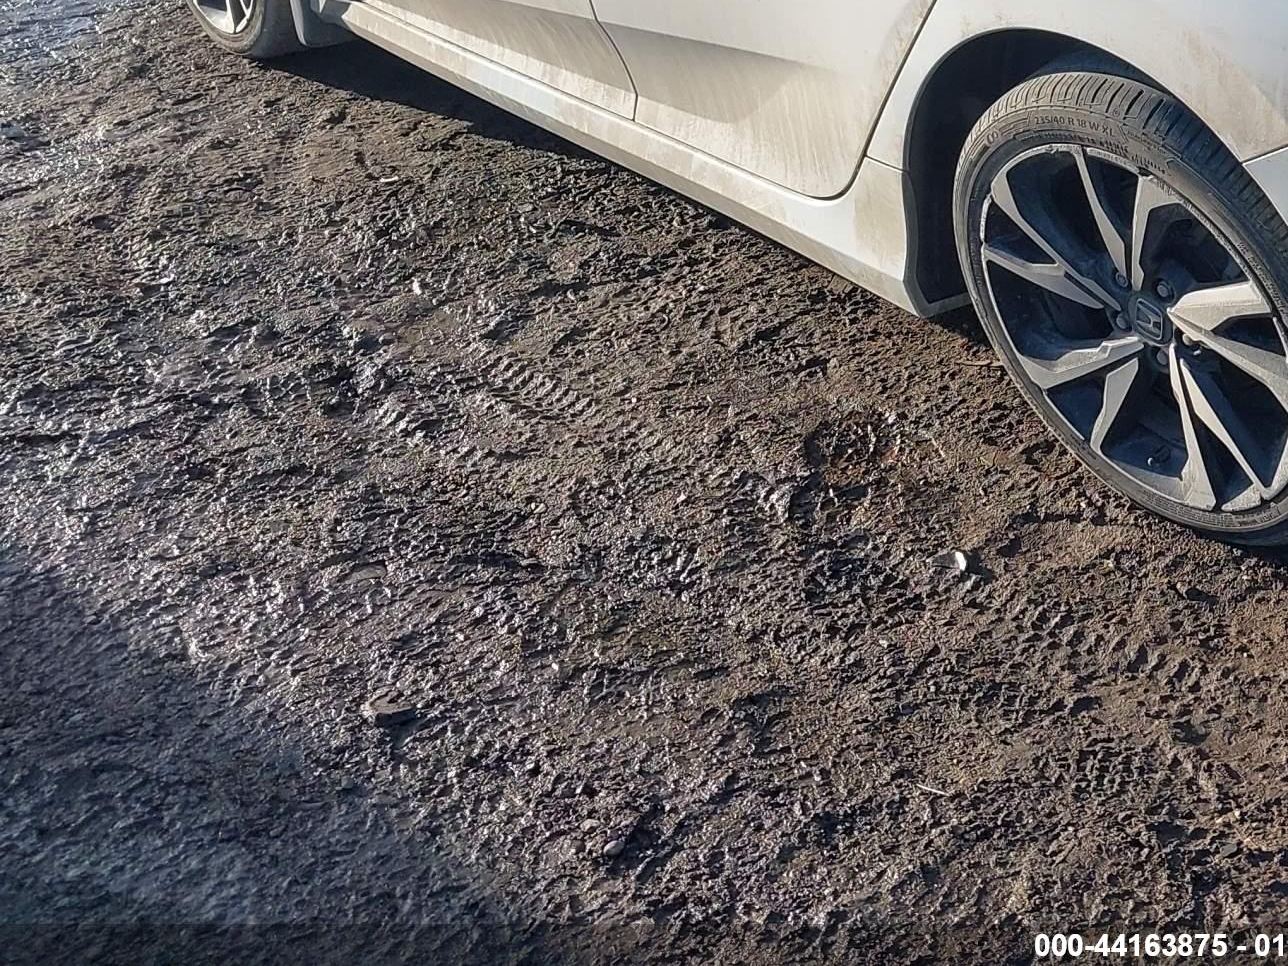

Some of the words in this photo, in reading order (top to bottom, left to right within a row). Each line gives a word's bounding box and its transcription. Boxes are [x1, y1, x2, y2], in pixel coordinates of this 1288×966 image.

[1067, 116, 1075, 126] R
[1077, 118, 1087, 129] 18
[1088, 121, 1100, 132] W
